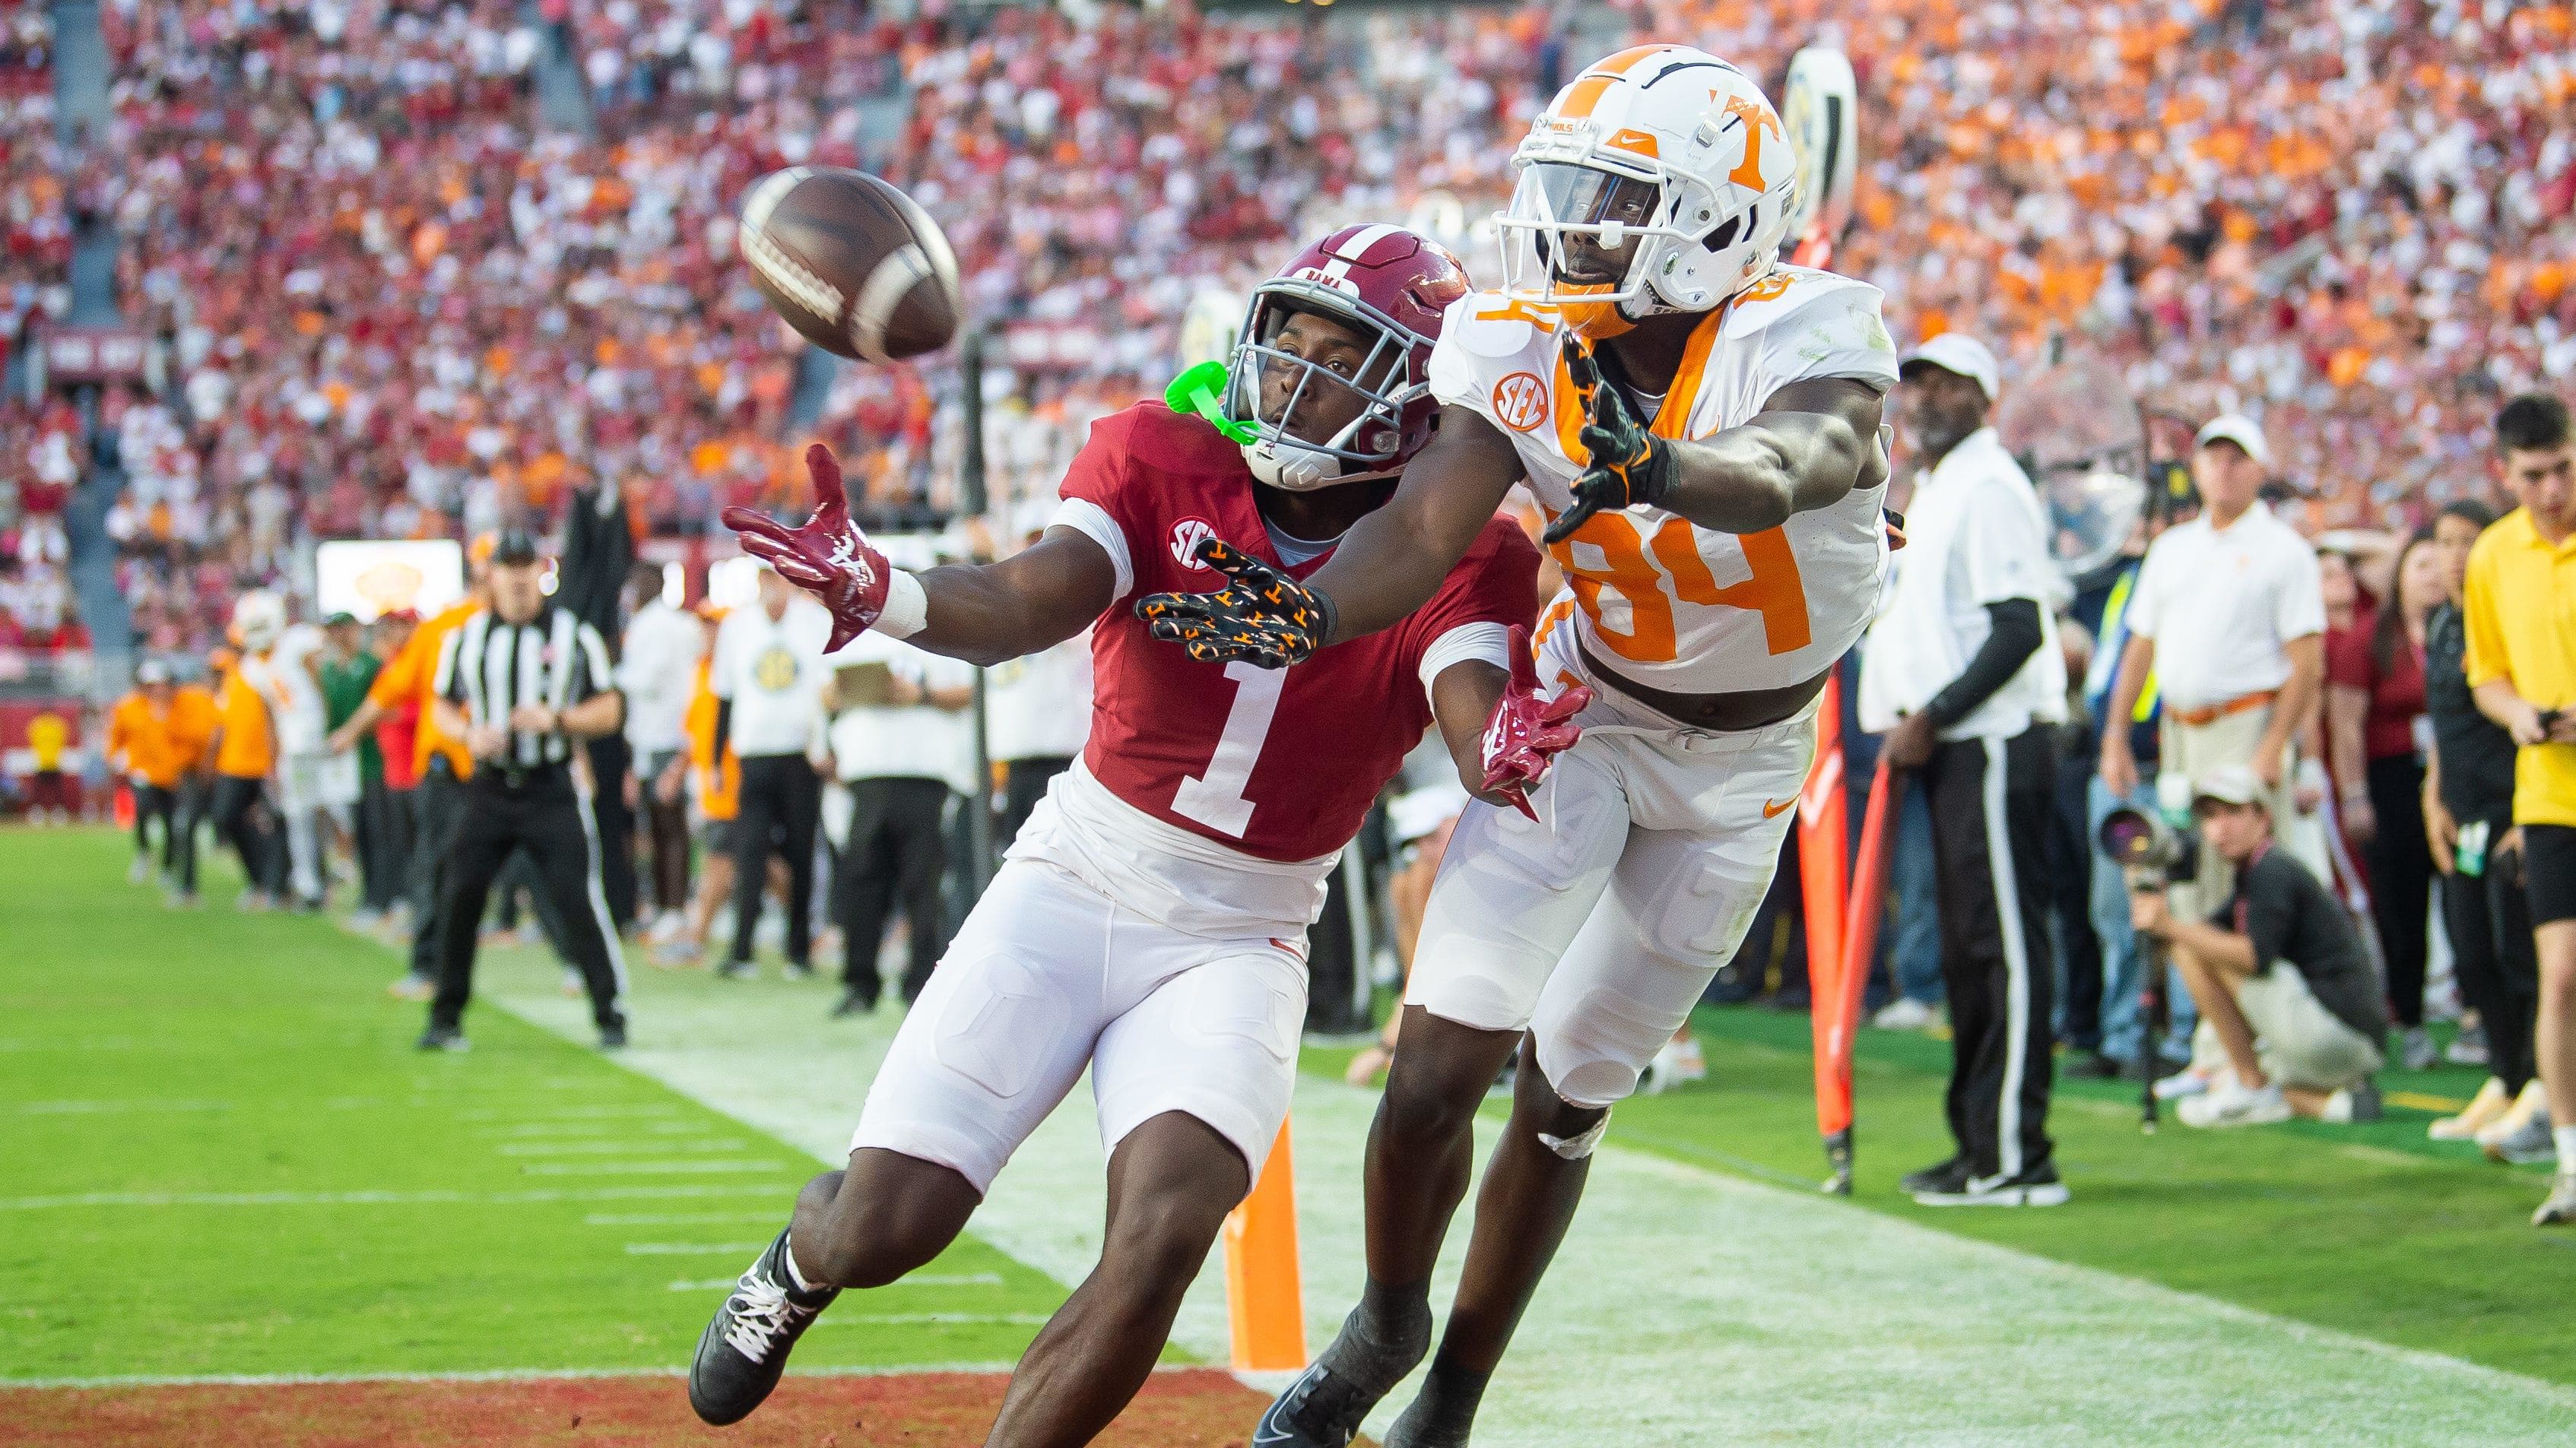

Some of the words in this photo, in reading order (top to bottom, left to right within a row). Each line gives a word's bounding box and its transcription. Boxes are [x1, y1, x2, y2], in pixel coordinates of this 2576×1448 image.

[1709, 89, 1780, 194] T
[1305, 271, 1340, 290] BAMA
[1497, 375, 1545, 428] SEC
[1547, 511, 1813, 663] 84
[1170, 660, 1289, 839] 1
